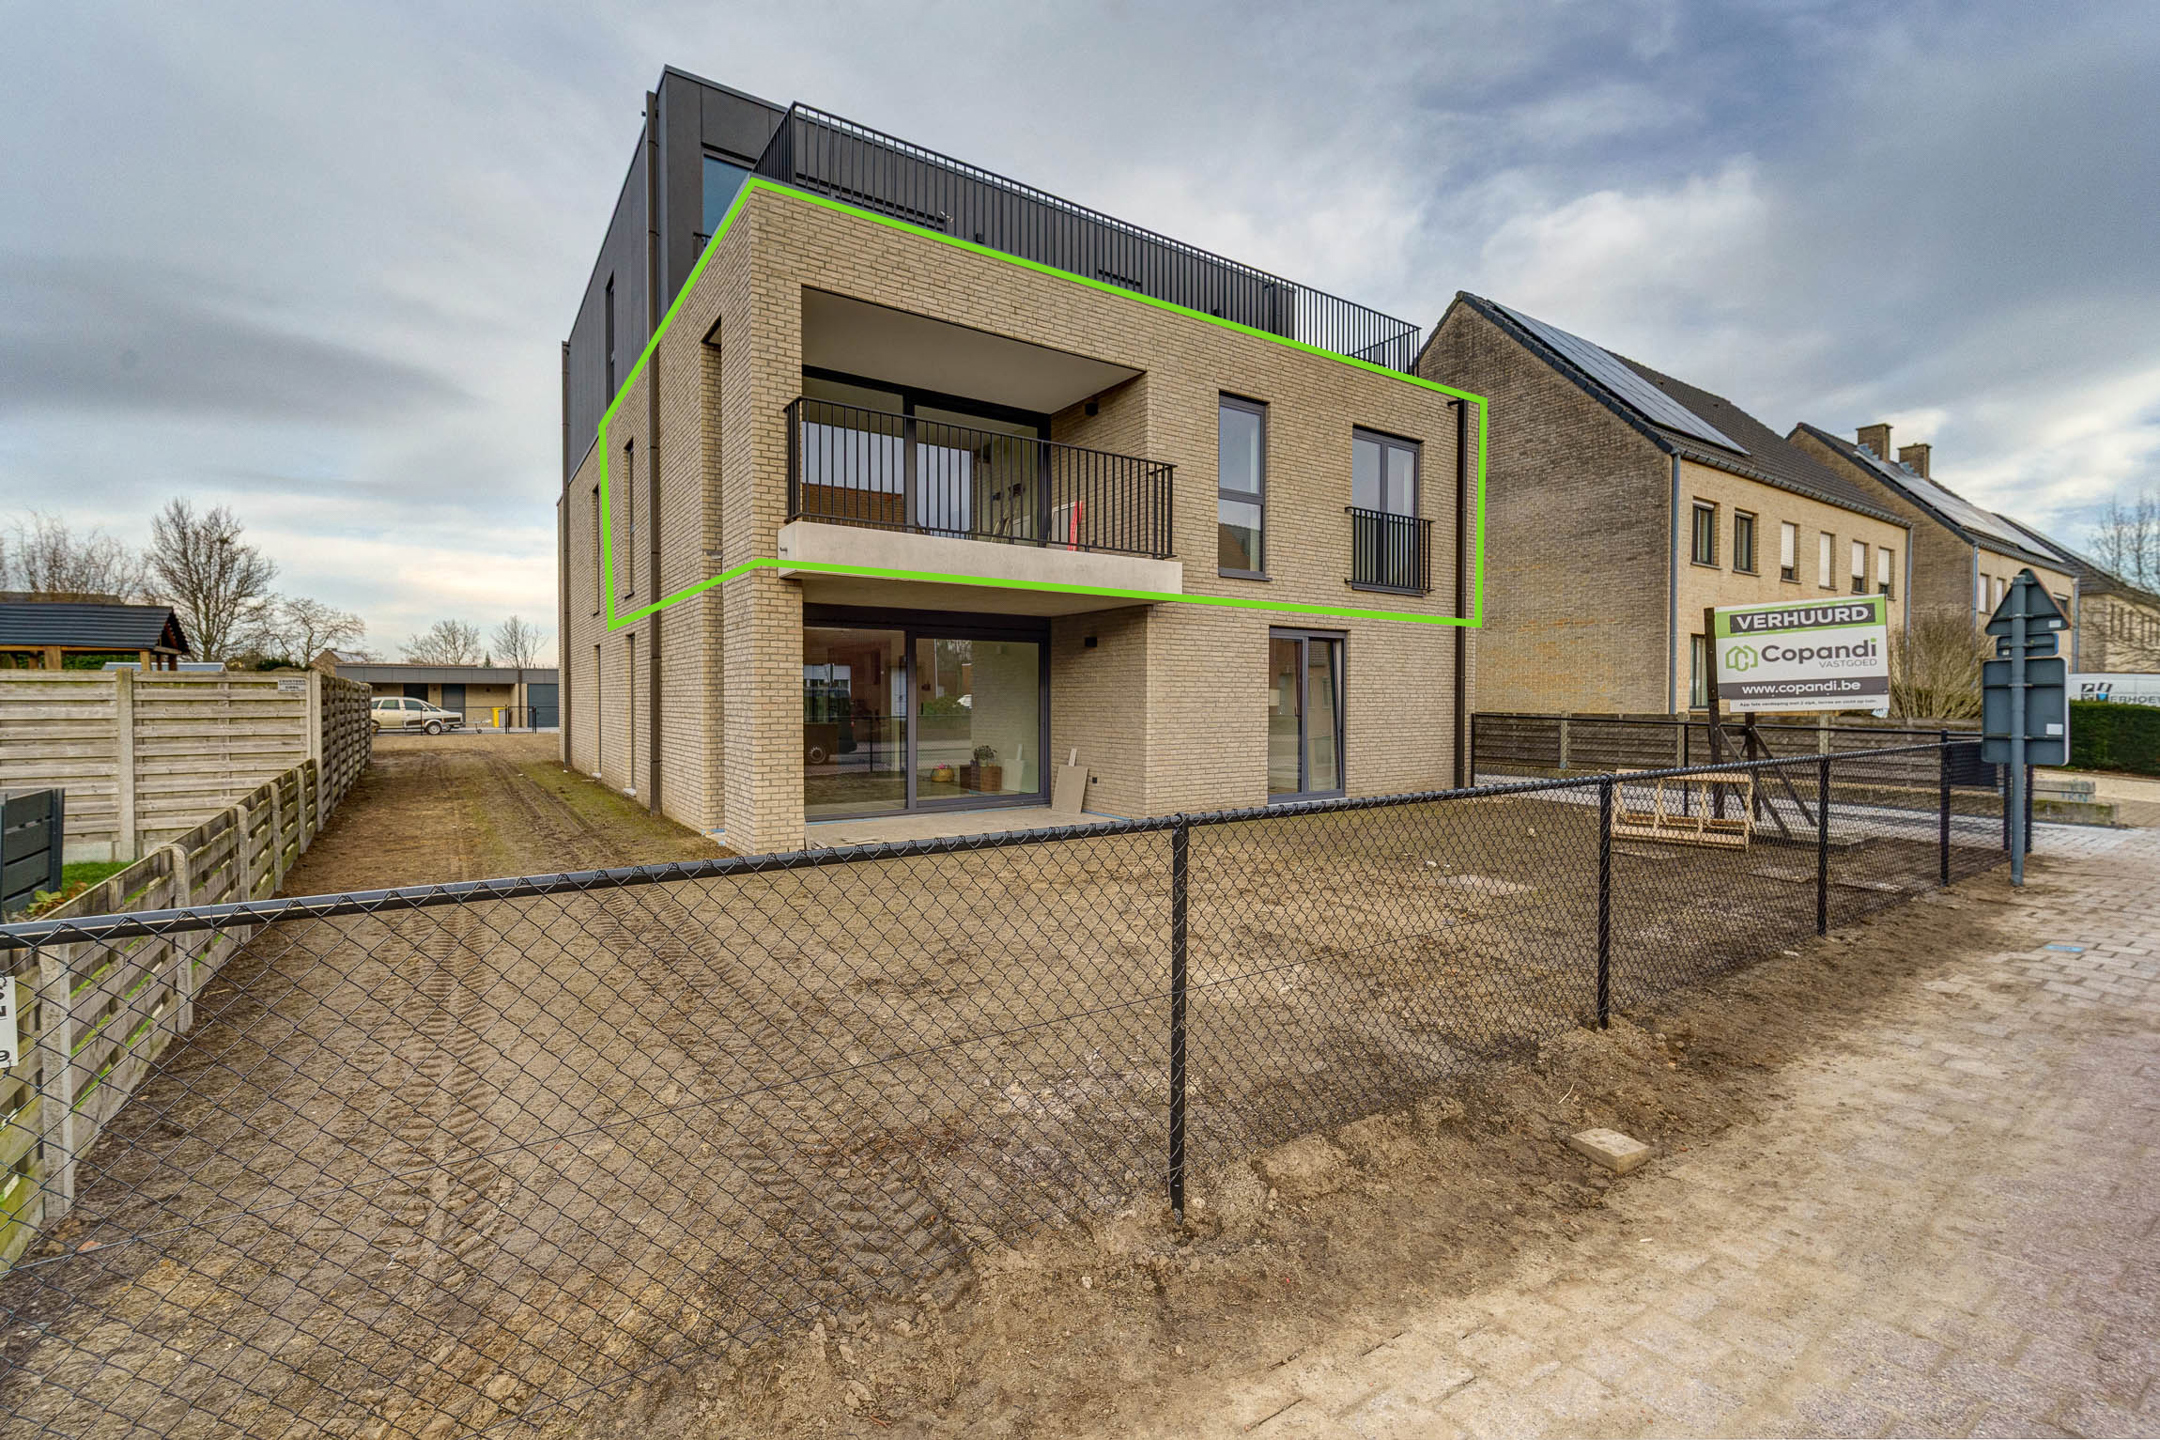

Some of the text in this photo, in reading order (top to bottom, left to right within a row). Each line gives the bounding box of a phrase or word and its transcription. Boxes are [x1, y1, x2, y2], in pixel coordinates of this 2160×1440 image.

[1736, 606, 1869, 630] VERHUURD
[1761, 637, 1877, 664] Copandi
[1818, 658, 1877, 669] VASTGOED
[1741, 680, 1861, 695] www.copandi.be
